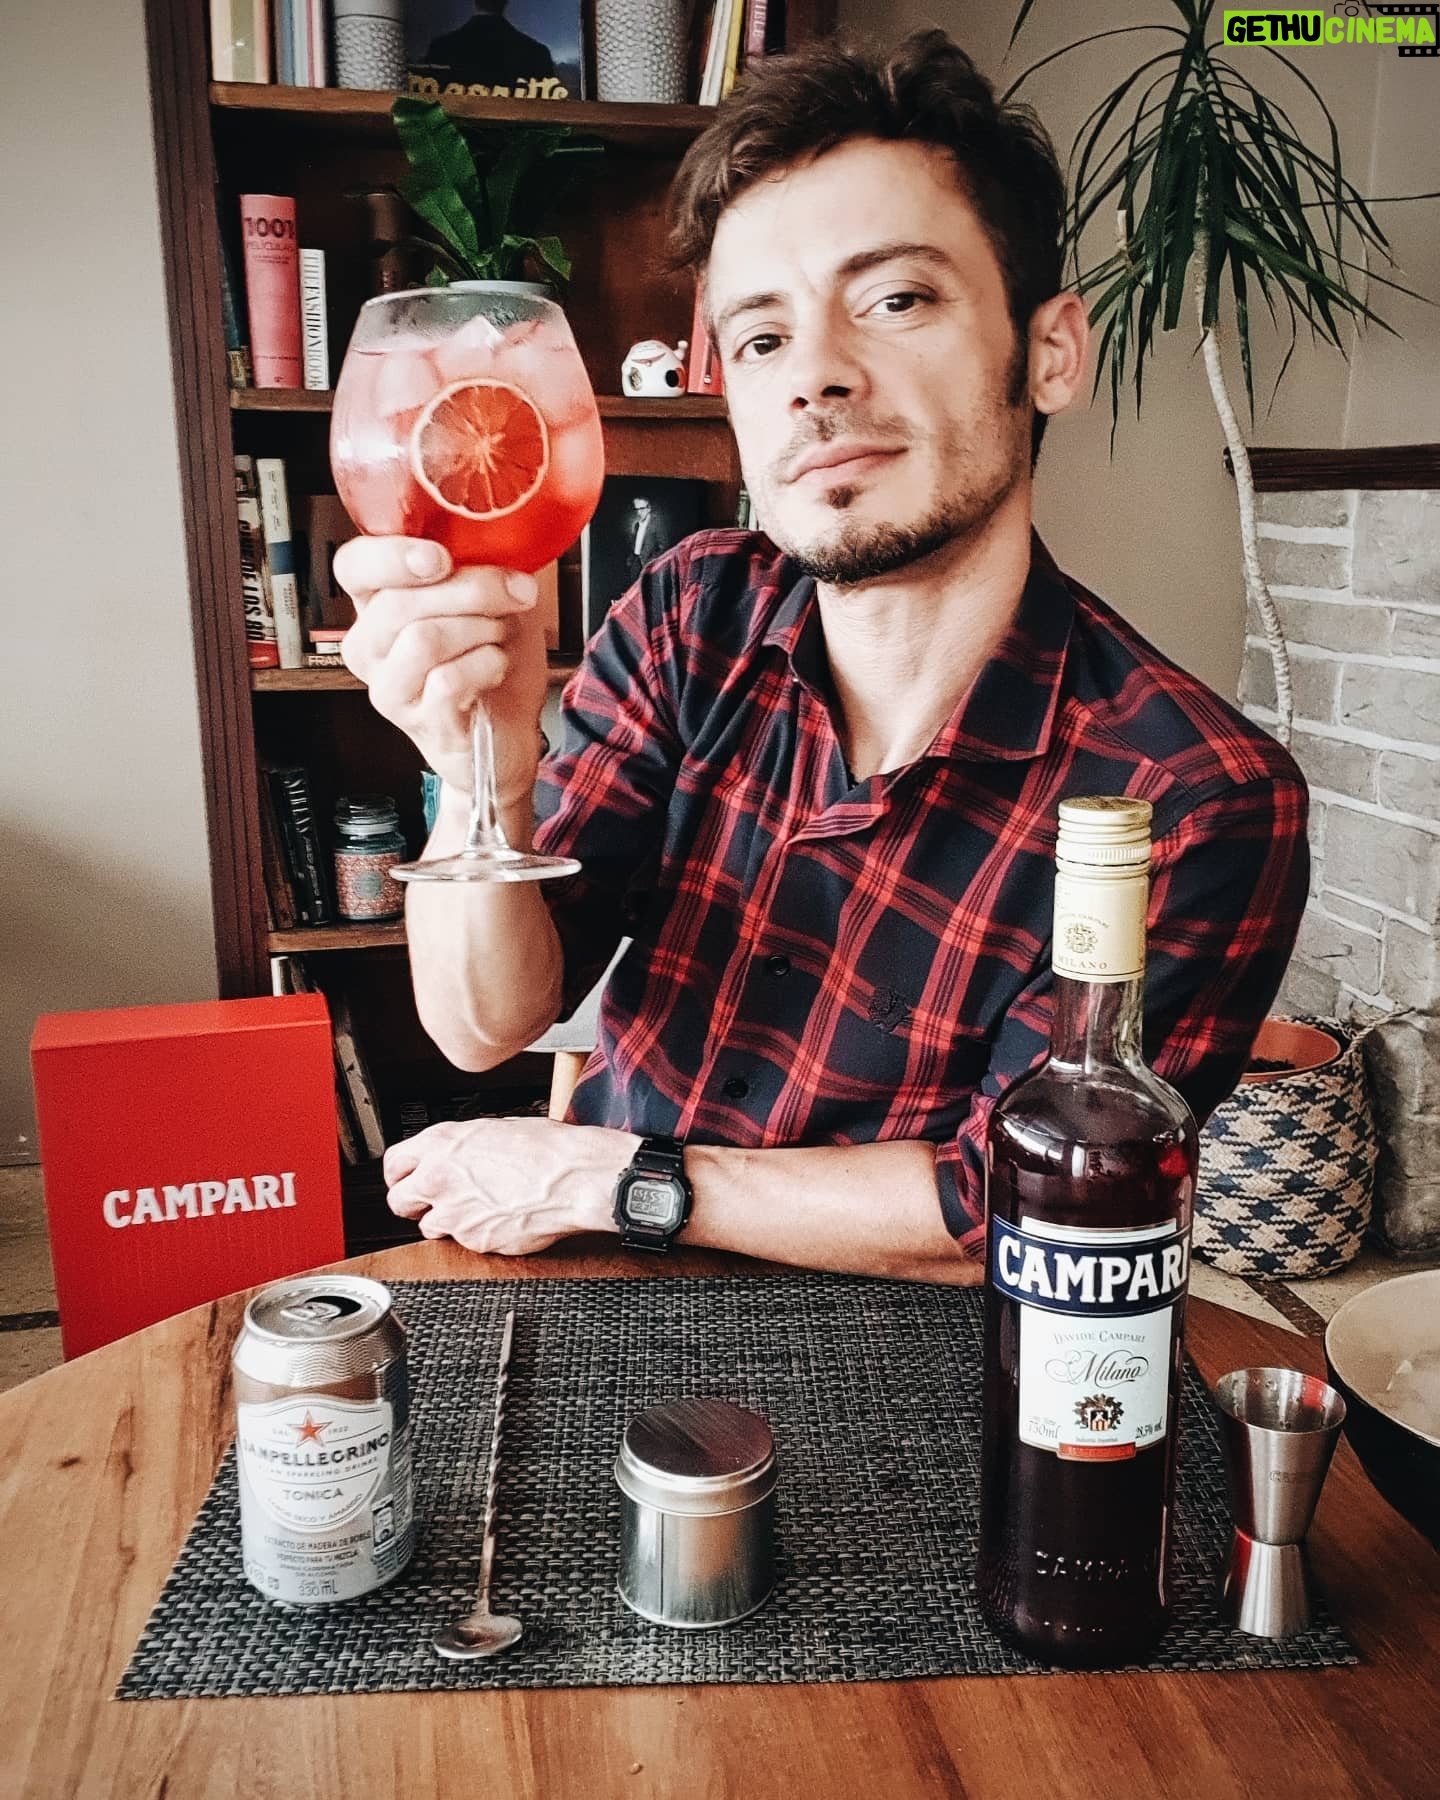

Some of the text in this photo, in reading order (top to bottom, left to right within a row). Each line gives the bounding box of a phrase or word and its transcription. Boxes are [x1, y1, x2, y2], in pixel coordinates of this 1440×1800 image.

[102, 1171, 297, 1229] CAMPARI
[998, 1234, 1191, 1304] CAMPARI
[1044, 1349, 1149, 1390] Milano
